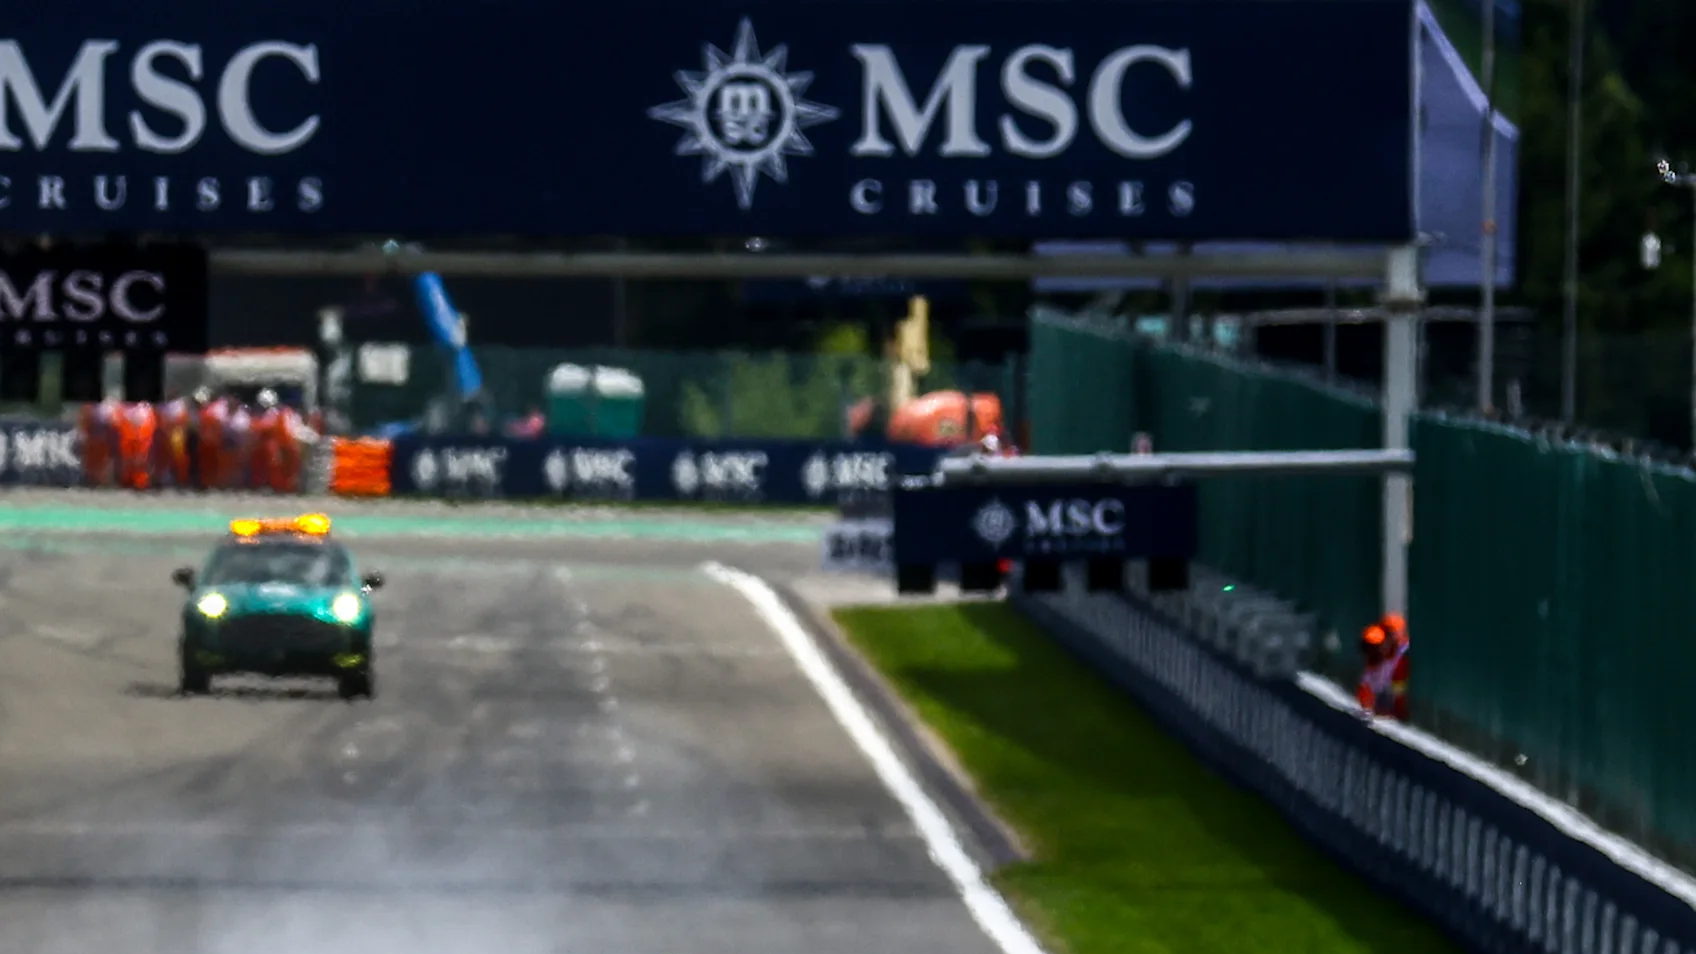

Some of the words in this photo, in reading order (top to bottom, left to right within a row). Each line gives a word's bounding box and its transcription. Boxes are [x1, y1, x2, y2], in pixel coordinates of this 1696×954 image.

[851, 44, 1193, 158] MSC
[851, 179, 1195, 215] CRUISES
[1025, 498, 1126, 536] MSC
